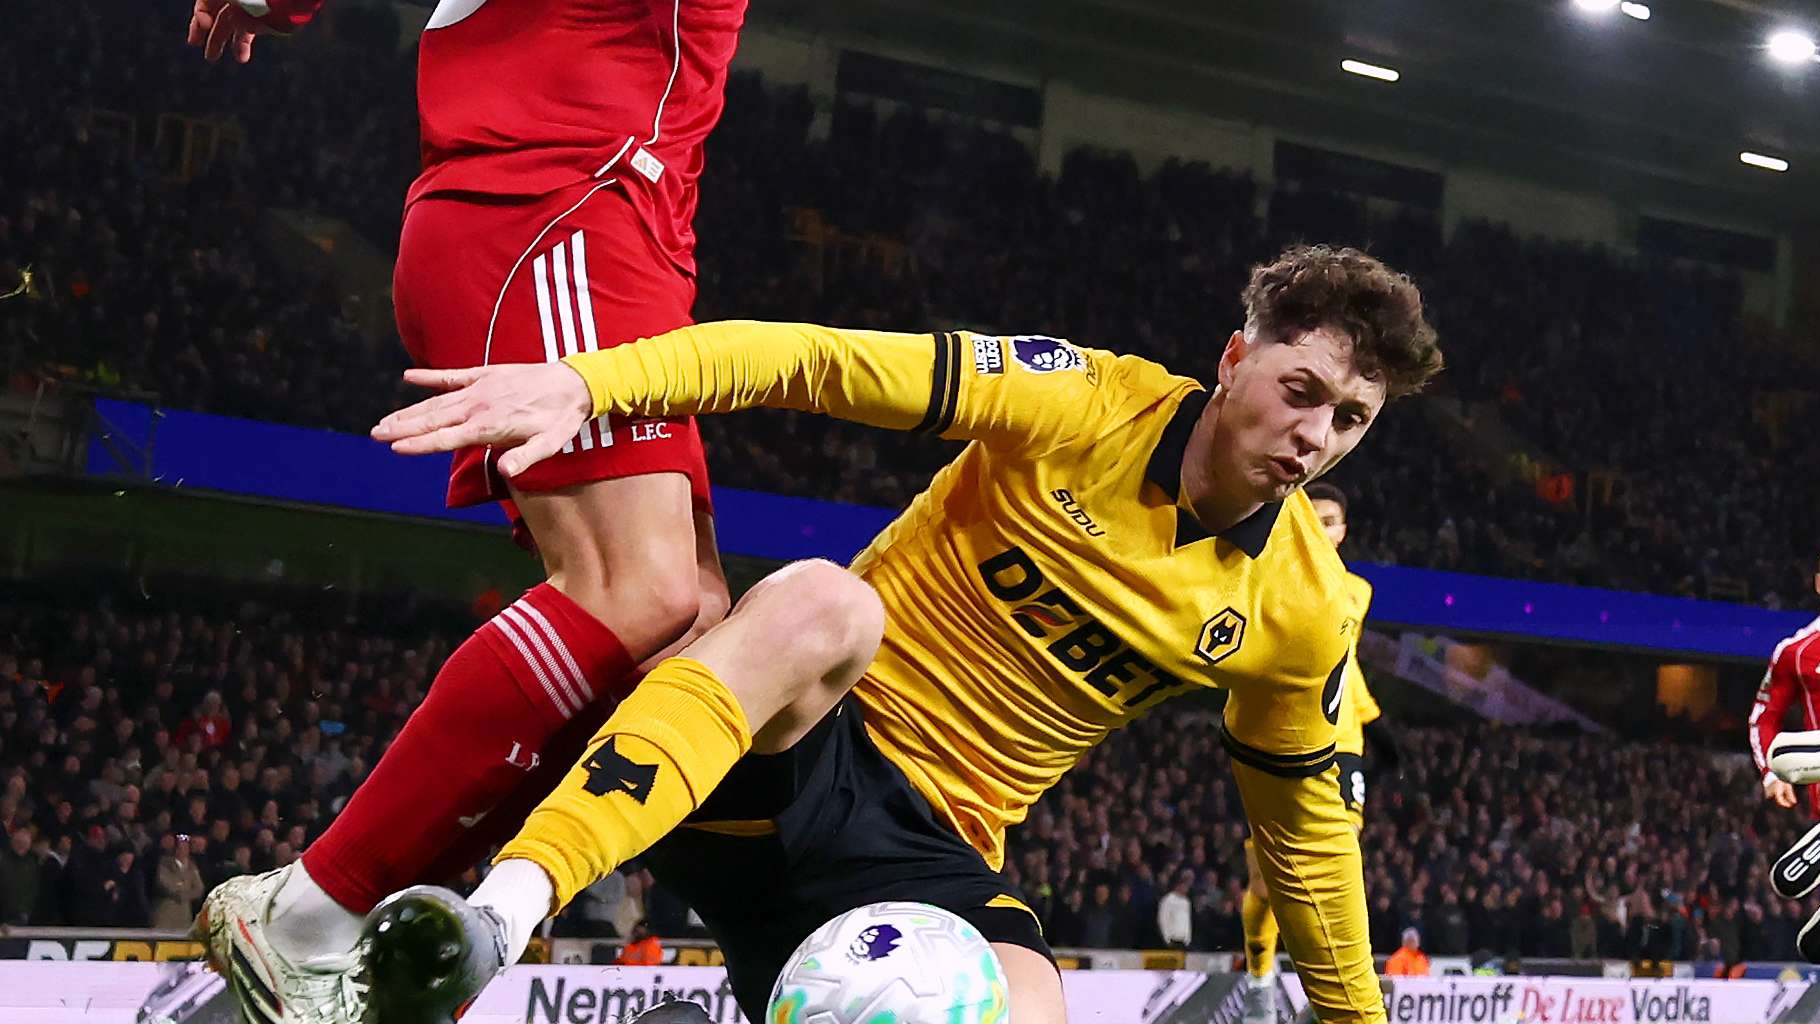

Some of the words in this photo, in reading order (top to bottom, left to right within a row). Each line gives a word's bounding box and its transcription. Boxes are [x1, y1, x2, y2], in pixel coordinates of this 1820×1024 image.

[1050, 488, 1107, 537] SUDU
[977, 545, 1185, 708] DEBET
[1631, 985, 1710, 1022] Vodka
